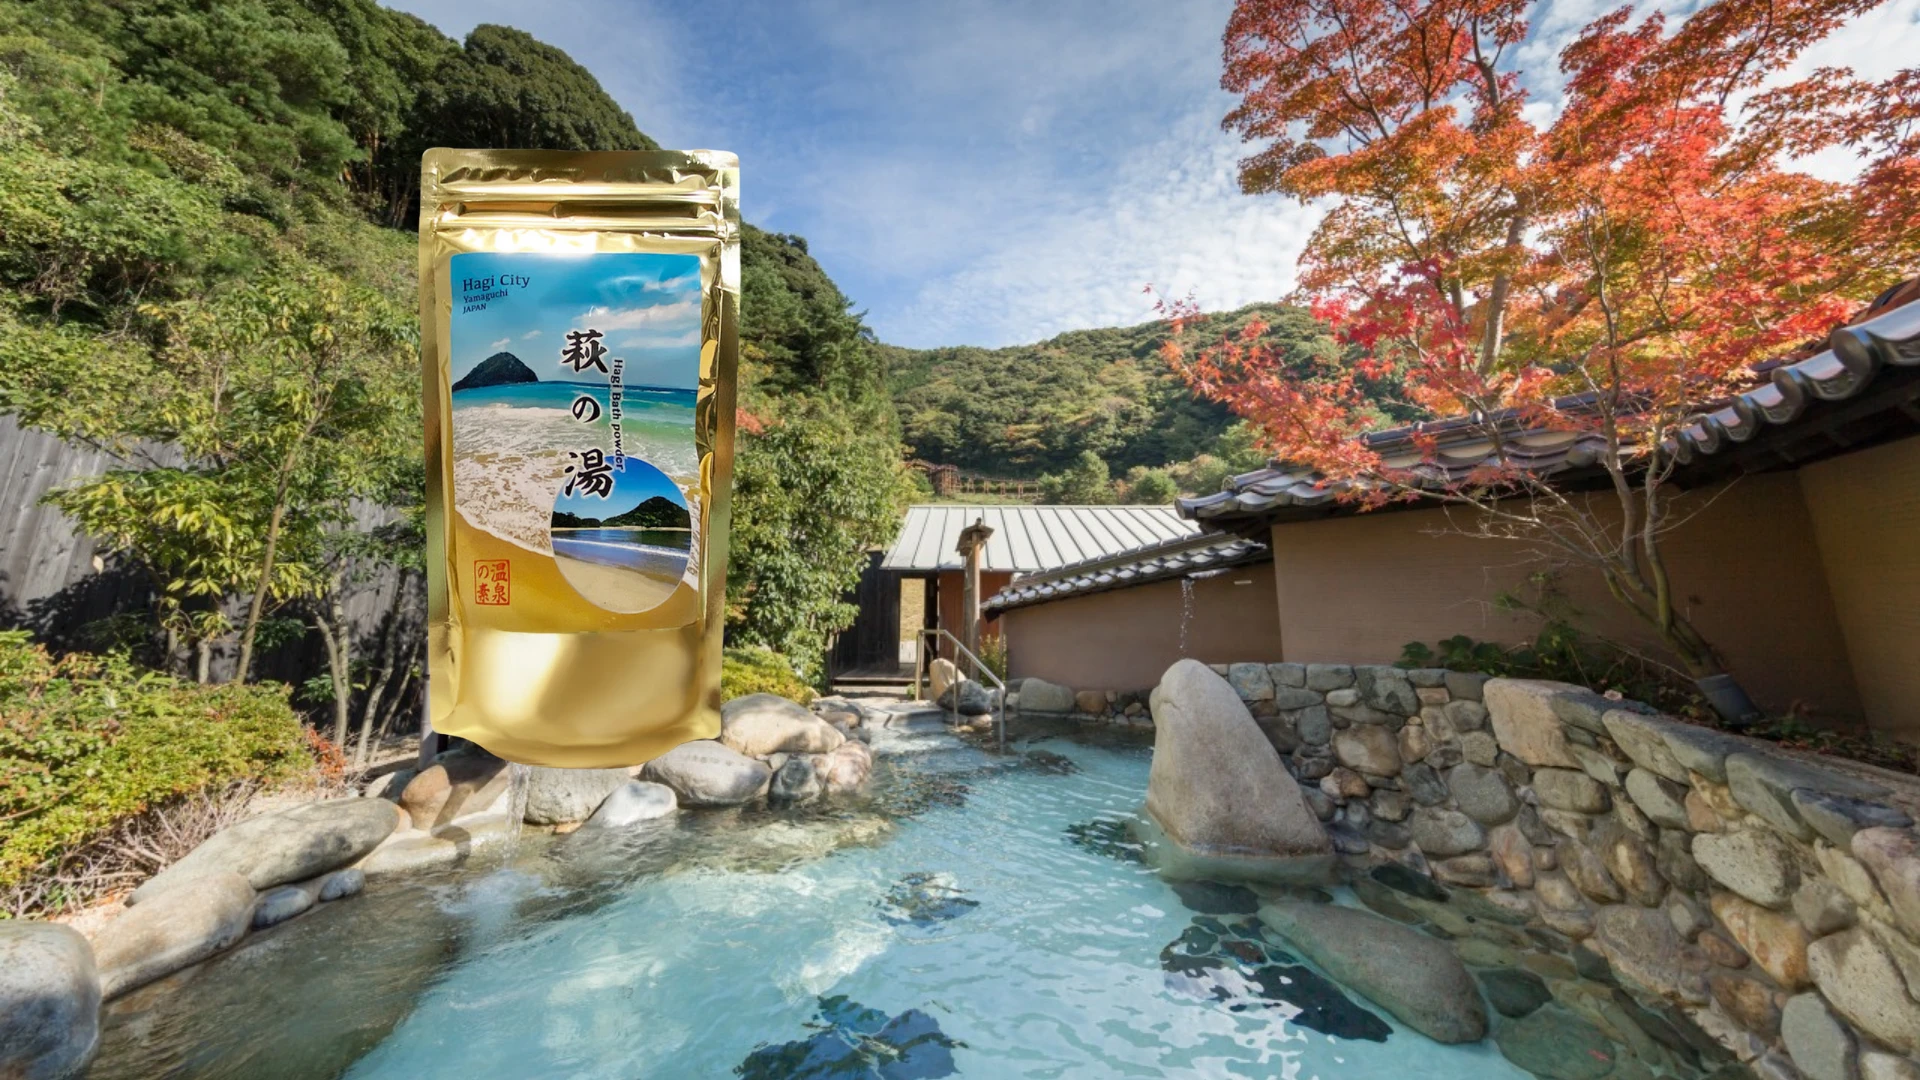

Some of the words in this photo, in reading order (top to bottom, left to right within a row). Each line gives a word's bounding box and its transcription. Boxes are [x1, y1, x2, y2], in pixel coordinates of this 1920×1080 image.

[463, 275, 495, 292] Hagi
[500, 274, 530, 289] City
[463, 288, 508, 304] Yamaguchi
[463, 303, 487, 315] JAPAN
[610, 359, 623, 389] Hagi
[561, 329, 613, 498] 萩の湯
[611, 392, 622, 420] Bath
[611, 423, 625, 471] powder
[477, 564, 490, 604] の素
[490, 562, 508, 604] 温泉
